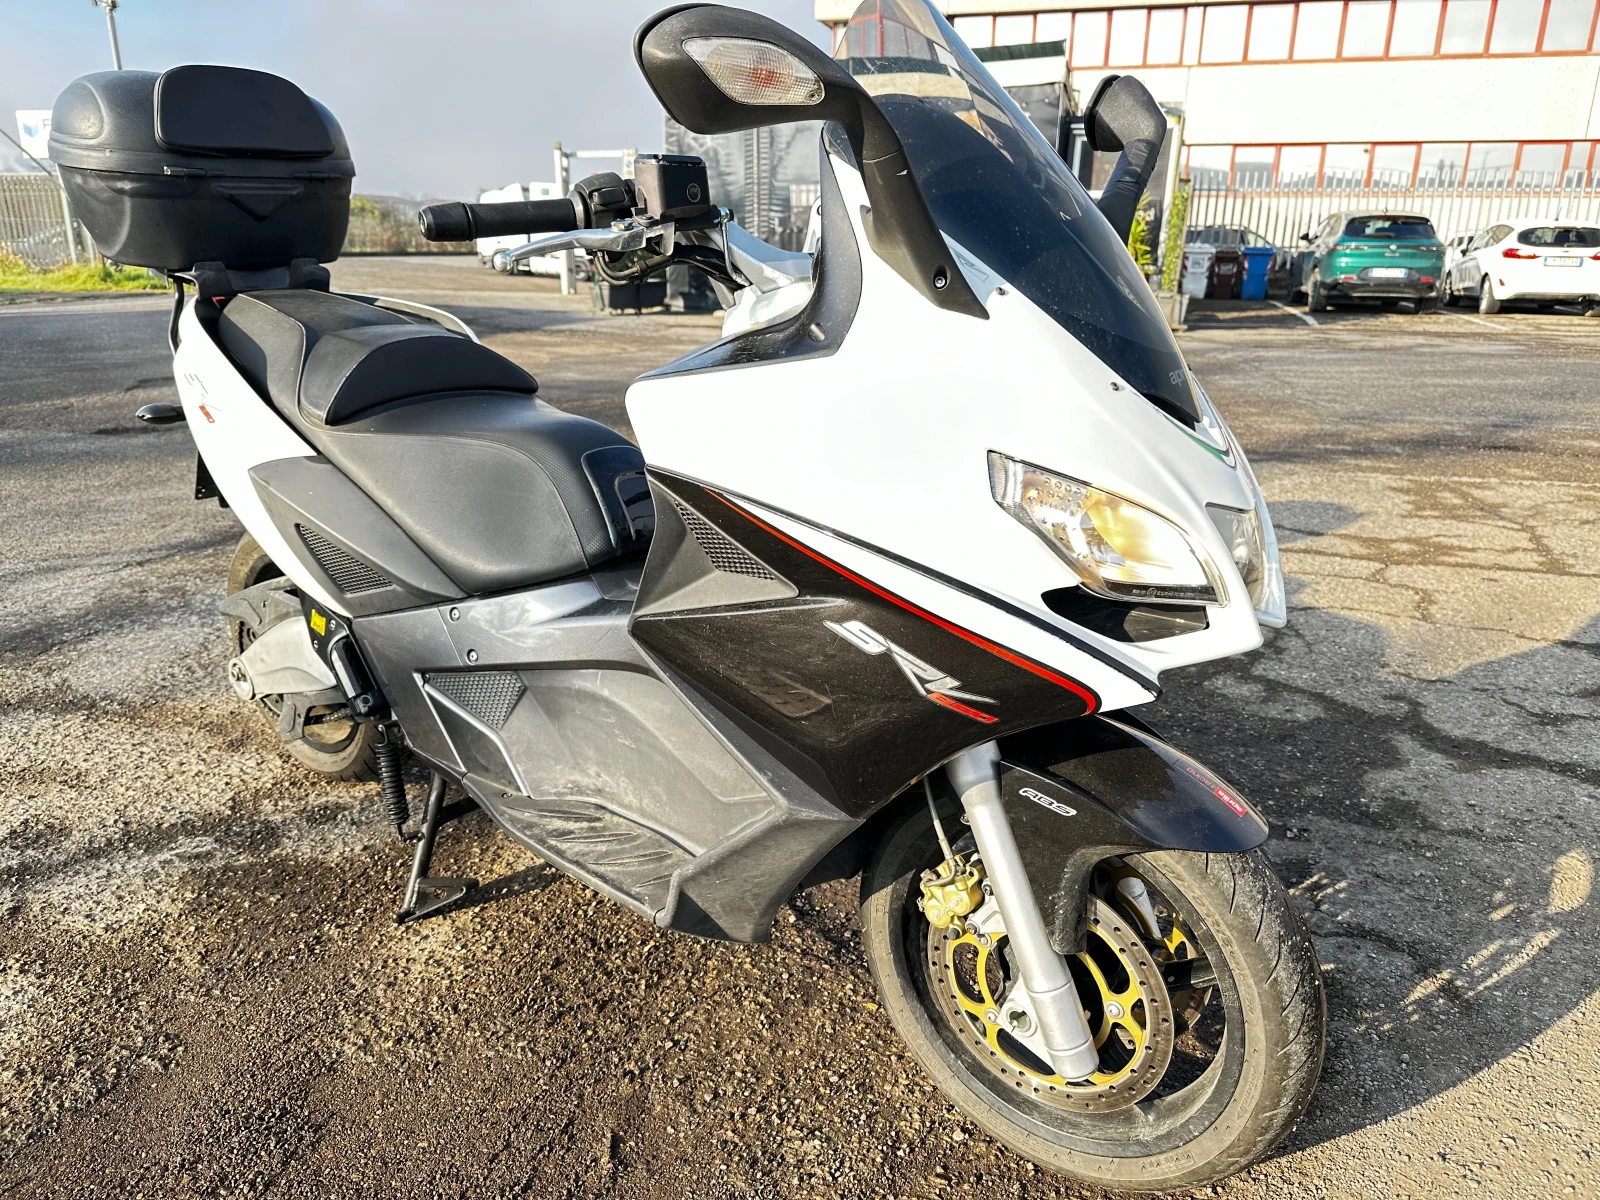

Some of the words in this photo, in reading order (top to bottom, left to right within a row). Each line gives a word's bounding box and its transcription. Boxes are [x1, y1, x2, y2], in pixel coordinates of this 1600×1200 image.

[1186, 766, 1215, 789] racing
[1019, 787, 1078, 817] ABS
[1217, 790, 1244, 813] aprilia
